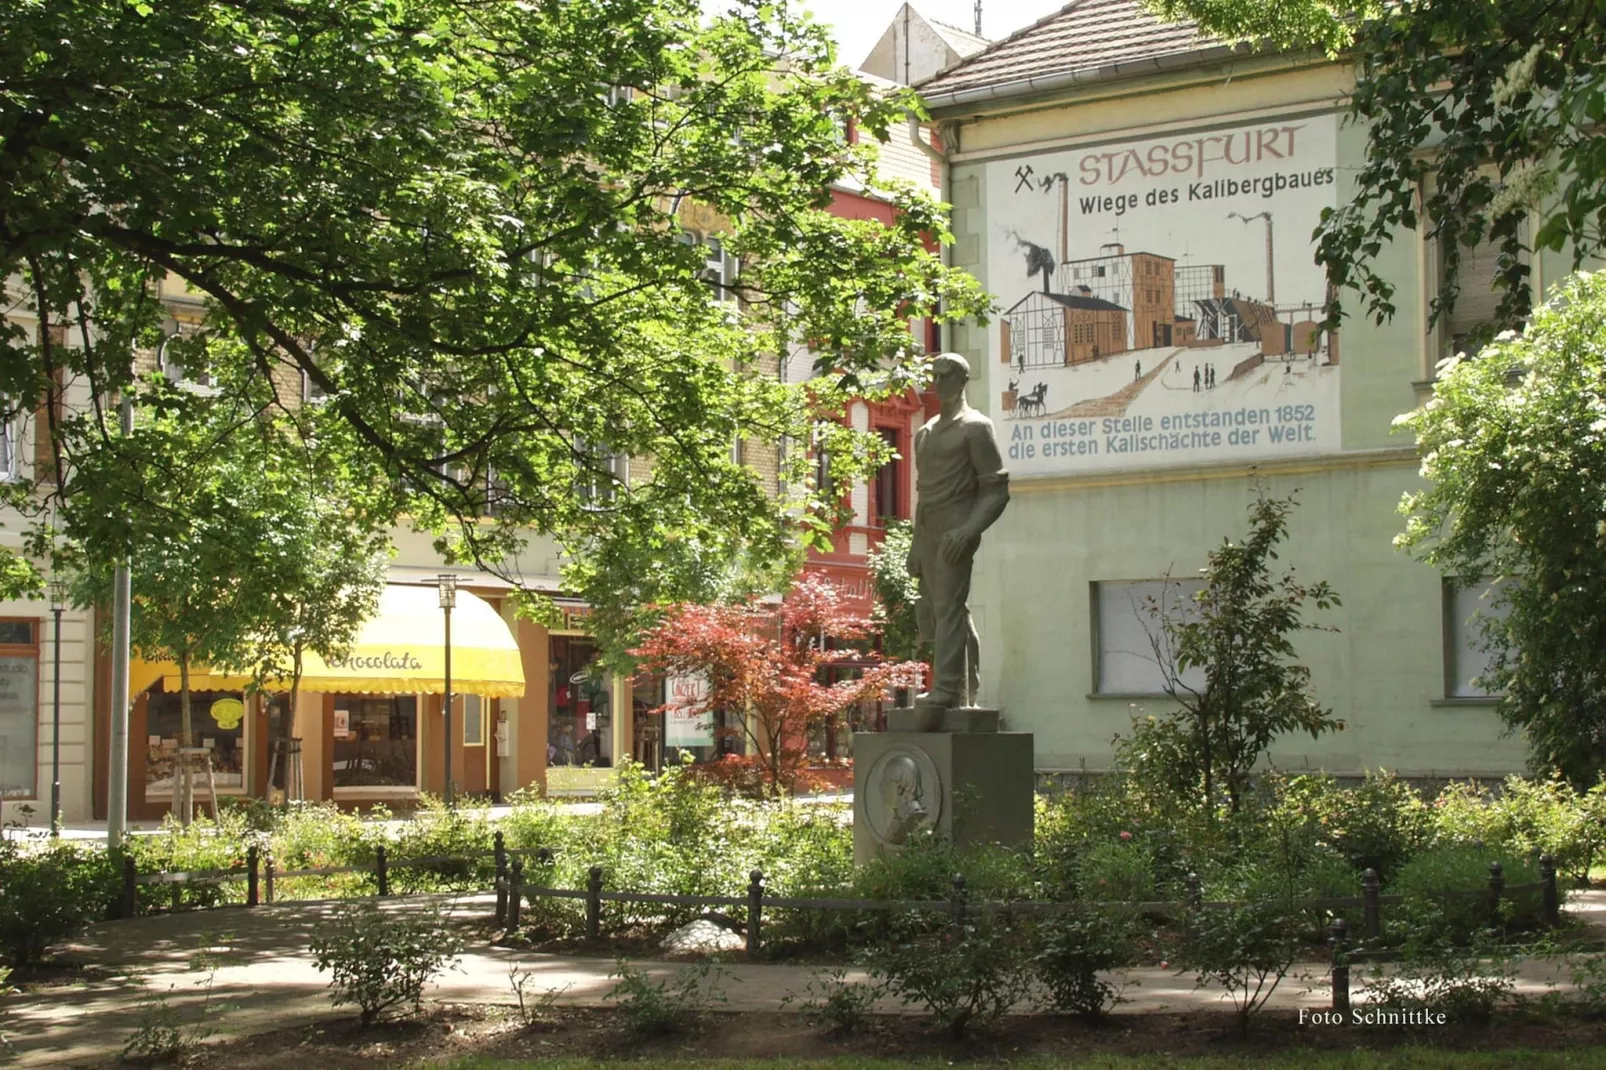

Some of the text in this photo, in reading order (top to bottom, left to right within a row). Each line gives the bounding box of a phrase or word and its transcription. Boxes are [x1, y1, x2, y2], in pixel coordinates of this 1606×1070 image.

[1079, 125, 1306, 186] STASSFURT
[1079, 168, 1335, 216] Wiege des Kalibergbaues
[1008, 423, 1317, 460] die ersten Kalischächte der Welt.
[1011, 404, 1316, 442] An dieser Stelle entstanden 1852
